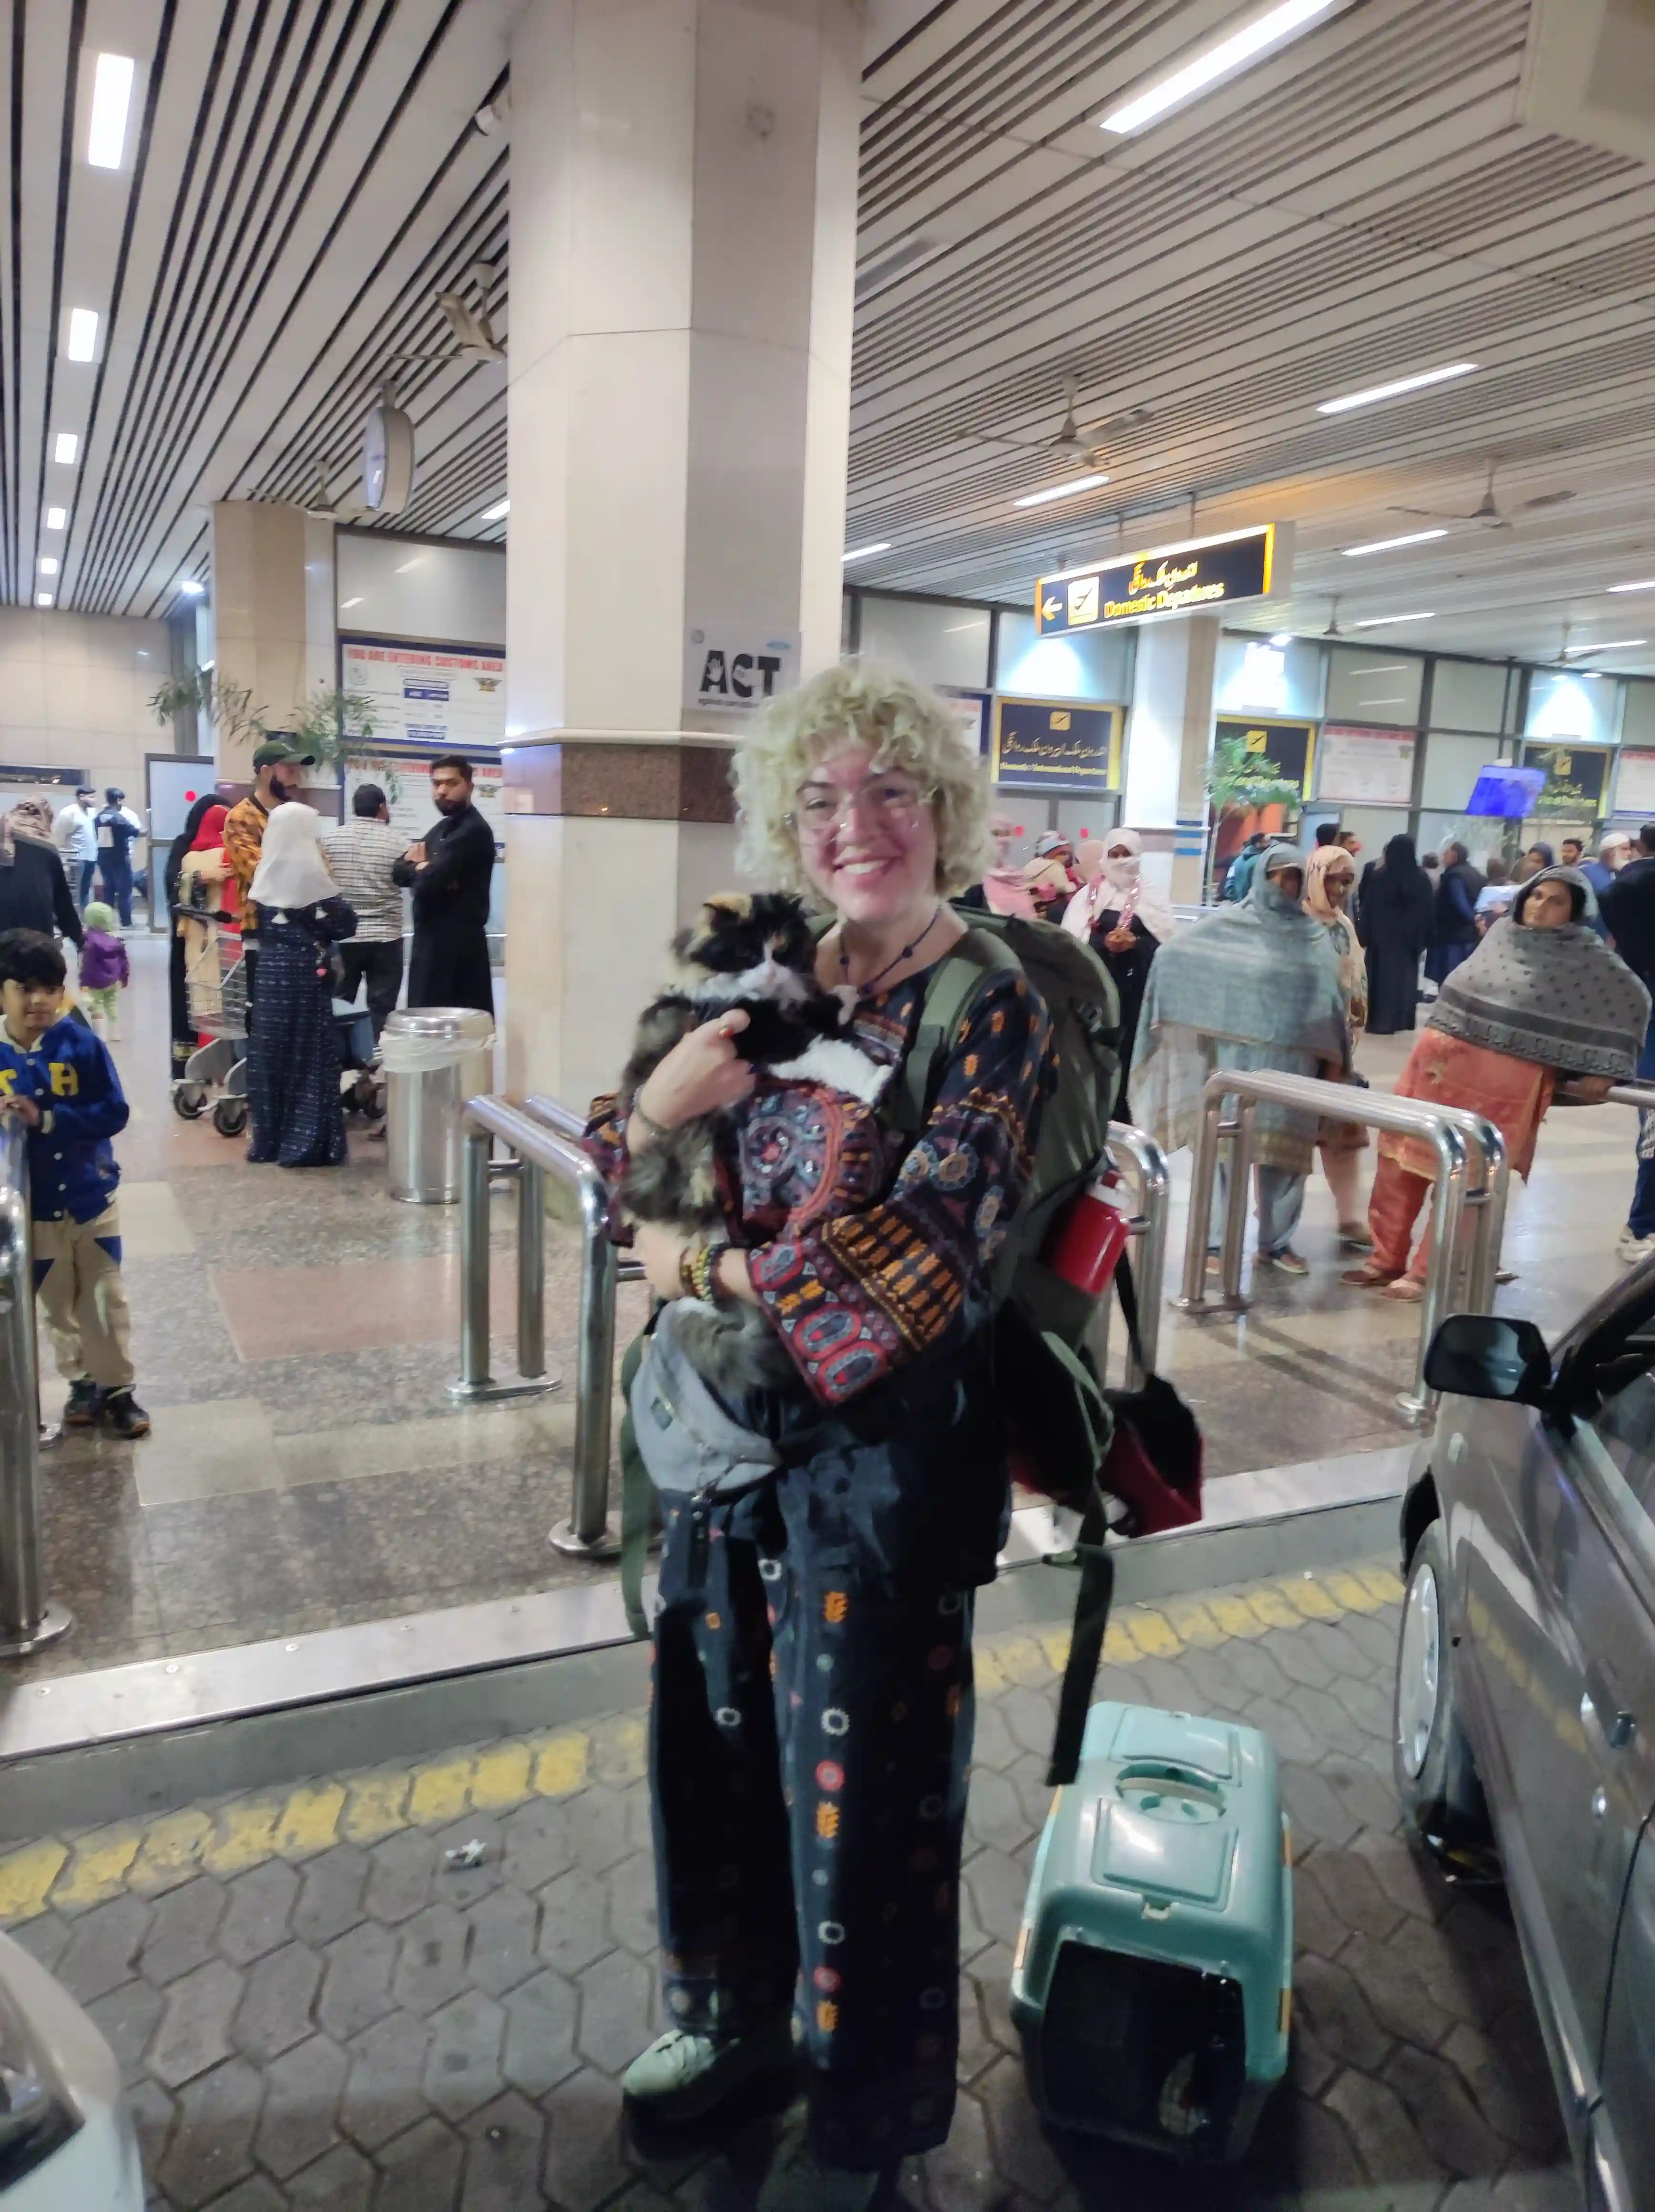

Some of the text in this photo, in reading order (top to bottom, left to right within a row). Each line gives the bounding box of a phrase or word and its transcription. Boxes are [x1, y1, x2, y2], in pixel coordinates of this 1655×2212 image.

[1103, 583, 1225, 618] Domestic Departures
[699, 650, 782, 698] ACT
